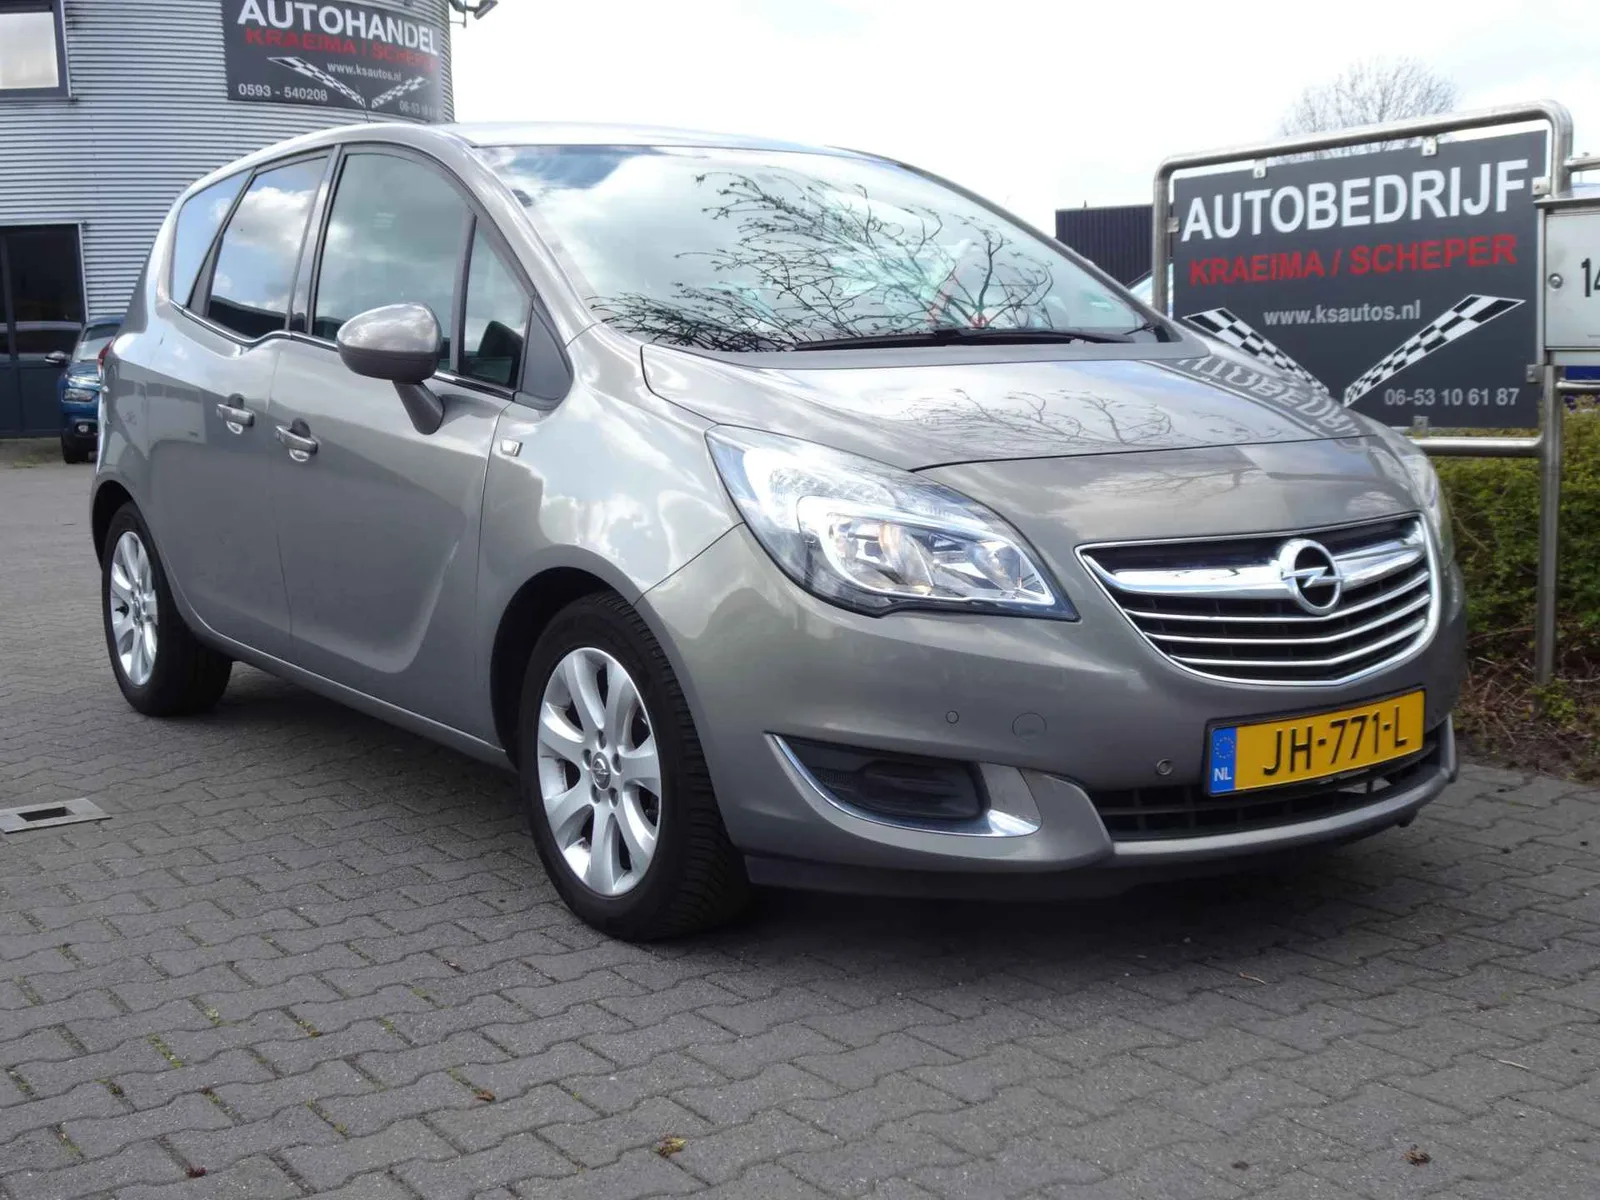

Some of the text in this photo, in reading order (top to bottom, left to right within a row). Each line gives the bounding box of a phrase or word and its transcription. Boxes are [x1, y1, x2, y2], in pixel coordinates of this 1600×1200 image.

[237, 0, 438, 56] AUTOHANDEL
[246, 27, 356, 56] KRAEIMA
[327, 62, 402, 80] www.ksautos.nl
[238, 84, 271, 97] 0593
[284, 86, 328, 101] 540208
[1181, 159, 1528, 242] AUTOBEDRIJF
[1190, 234, 1517, 285] KRAEIMA / SCHEPER
[1263, 300, 1421, 325] www.ksautos.nl
[1384, 388, 1520, 406] 06-53 10 61 87
[1263, 705, 1408, 776] JH-771-L
[1214, 767, 1232, 781] NL
